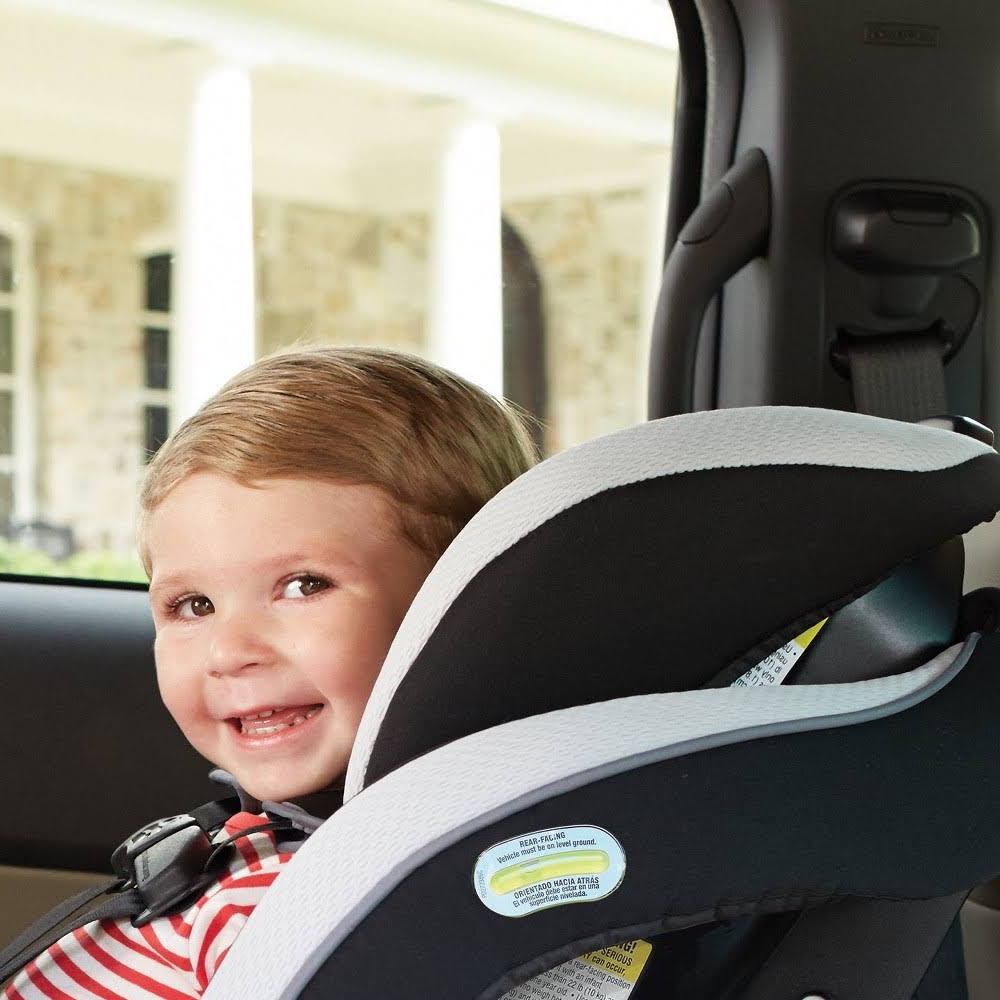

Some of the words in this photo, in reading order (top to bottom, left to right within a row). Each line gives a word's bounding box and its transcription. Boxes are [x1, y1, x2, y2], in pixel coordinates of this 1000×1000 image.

[520, 832, 565, 847] REAR-FACING
[497, 851, 520, 863] Vehicle
[521, 846, 536, 855] must
[556, 840, 571, 848] level
[573, 839, 596, 847] ground.
[514, 882, 551, 898] ORIENTADO
[554, 878, 575, 889] HACIA
[546, 888, 560, 897] debe
[591, 956, 604, 966] can
[601, 946, 633, 966] SERIOUS
